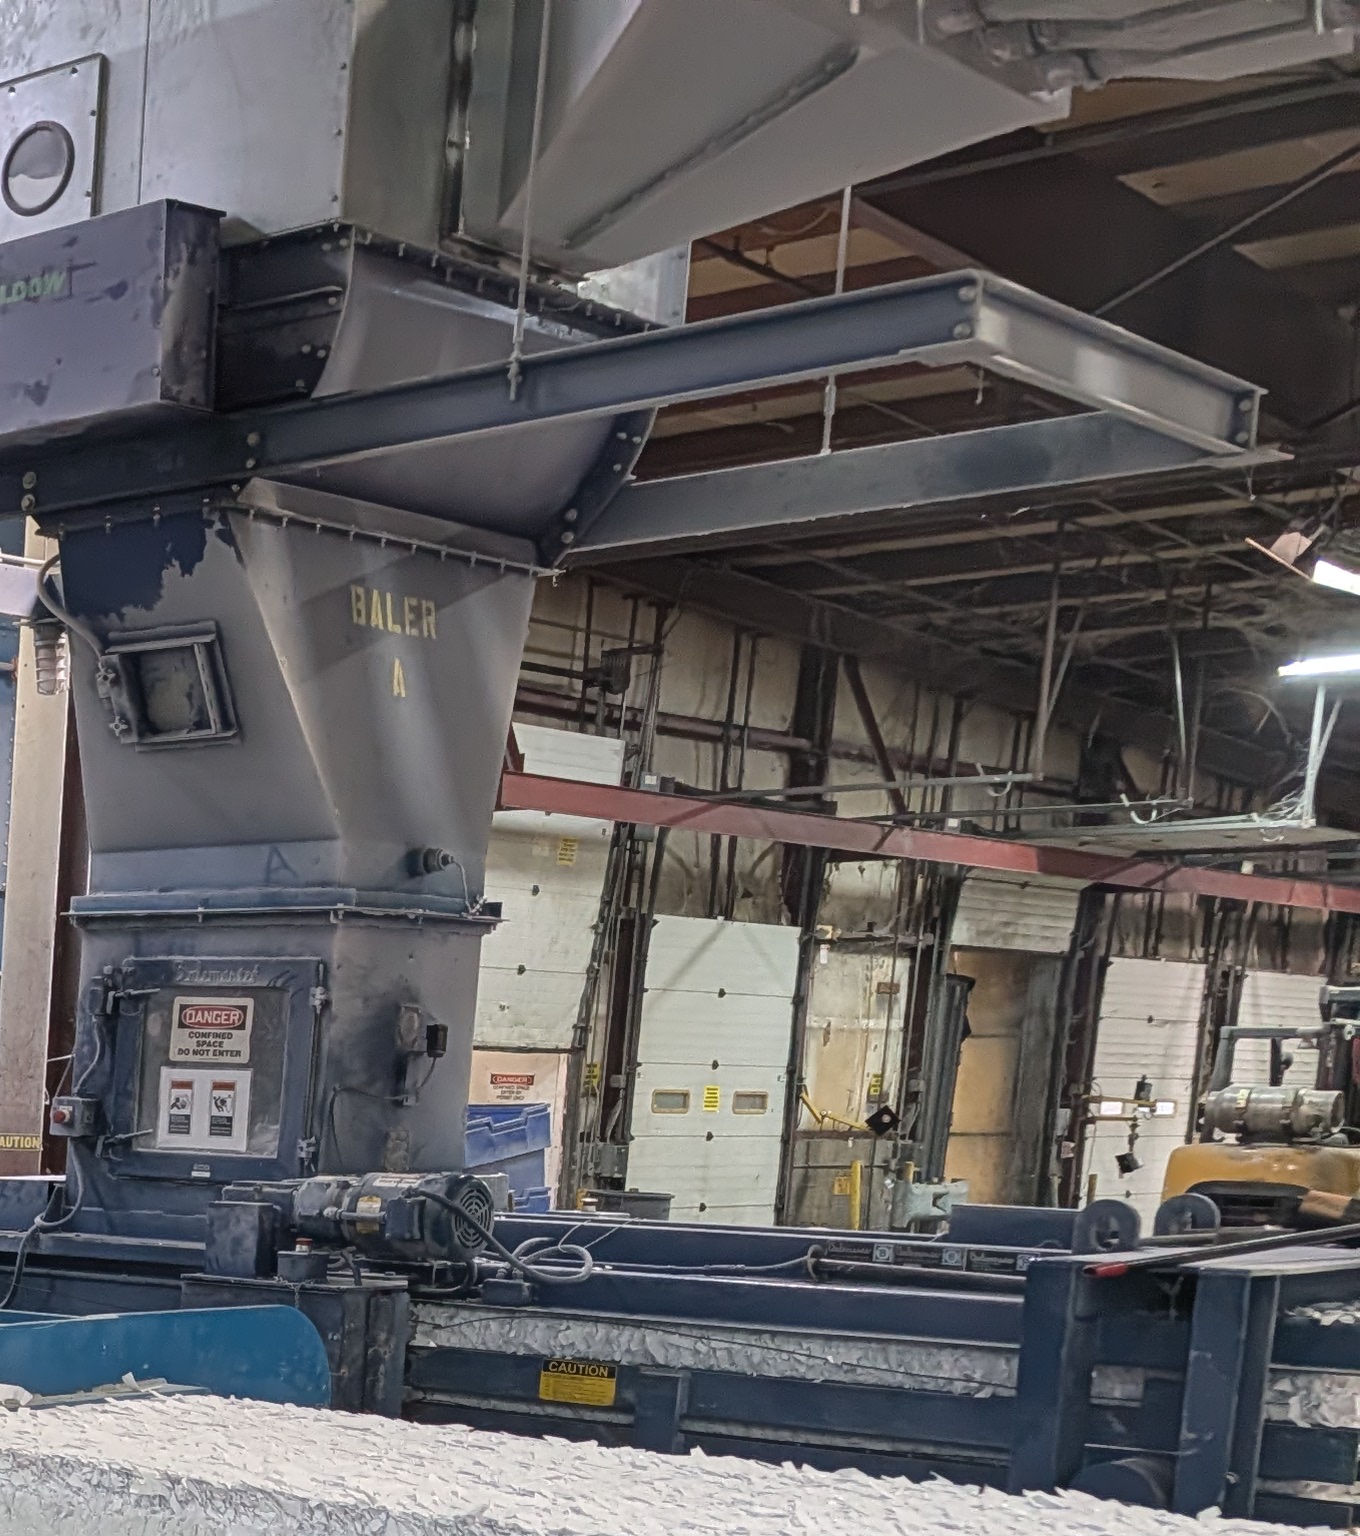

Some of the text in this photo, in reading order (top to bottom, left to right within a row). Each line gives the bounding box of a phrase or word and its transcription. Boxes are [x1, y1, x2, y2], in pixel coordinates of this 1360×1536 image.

[350, 584, 437, 639] BALER
[393, 657, 406, 698] A
[186, 1010, 240, 1024] DANGER
[188, 1031, 233, 1040] CONFINED
[196, 1040, 224, 1049] SPACE
[177, 1048, 242, 1058] DO NOT ENTER
[549, 1361, 609, 1377] CAUTION
